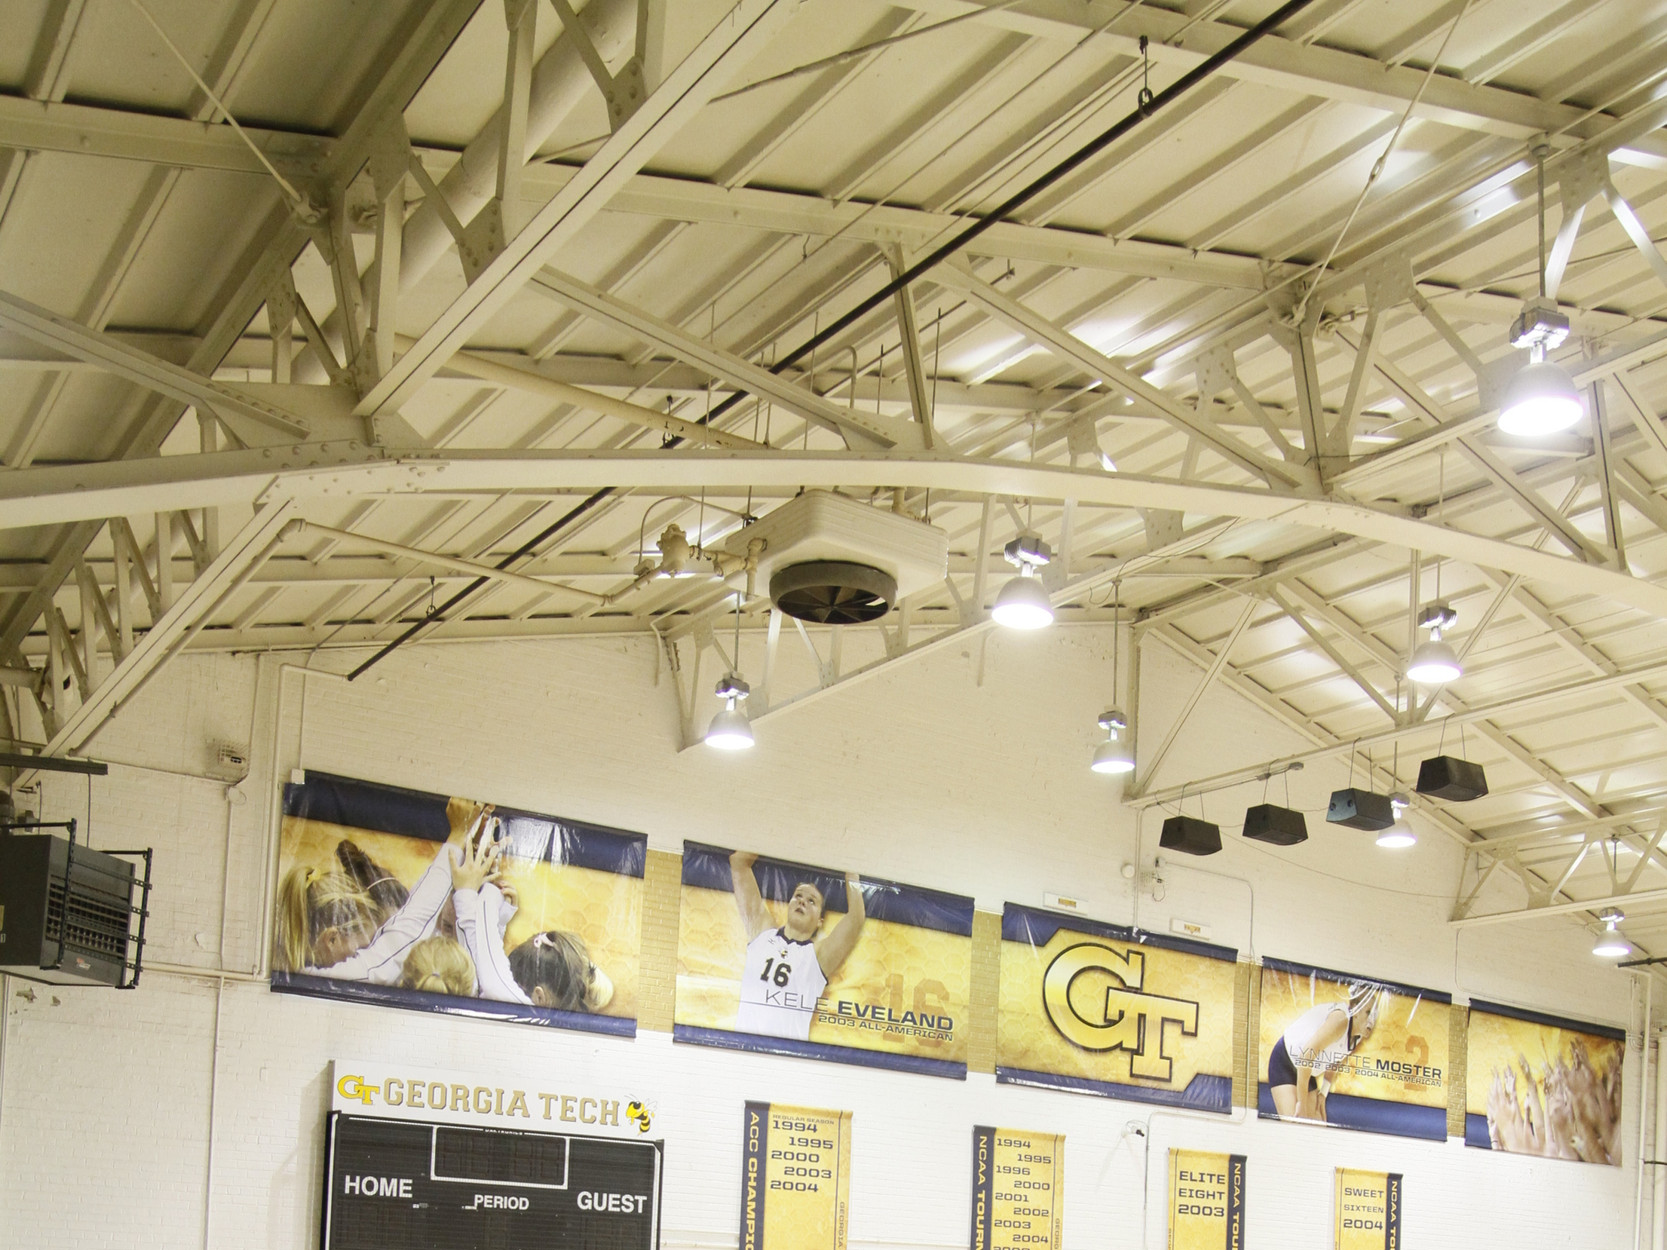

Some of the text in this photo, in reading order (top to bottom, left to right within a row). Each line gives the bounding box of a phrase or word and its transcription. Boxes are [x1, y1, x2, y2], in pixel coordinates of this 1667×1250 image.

[760, 957, 792, 988] 16
[765, 989, 954, 1031] KELE EVELAND
[818, 1014, 953, 1042] 2003 ALL-AMERICAN
[1290, 1045, 1442, 1080] LYNNETTE MOSTER
[1294, 1059, 1442, 1087] 2002 2003 2004 ALL-AMERICAN
[337, 1075, 620, 1126] GT GEORGIA TECH
[772, 1114, 834, 1125] REGULAR SEASON
[749, 1111, 760, 1152] ACC
[772, 1120, 818, 1133] 1994
[789, 1137, 834, 1149] 1995
[997, 1138, 1031, 1149] 1994
[771, 1150, 820, 1163] 2000
[978, 1135, 988, 1185] NCAA
[1017, 1154, 1052, 1164] 1995
[784, 1166, 832, 1179] 2003
[996, 1165, 1031, 1175] 1996
[1179, 1170, 1226, 1184] ELITE
[344, 1175, 413, 1199] HOME
[770, 1180, 819, 1192] 2004
[1014, 1180, 1050, 1191] 2000
[1233, 1163, 1241, 1208] NCAA
[994, 1192, 1029, 1202] 2001
[1178, 1188, 1225, 1200] EIGHT
[1344, 1187, 1385, 1198] SWEET
[474, 1194, 530, 1211] PERIOD
[576, 1190, 648, 1214] GUEST
[1390, 1181, 1398, 1222] NCAA
[1013, 1207, 1049, 1217] 2002
[1178, 1204, 1225, 1217] 2003
[1343, 1204, 1384, 1213] SIXTEEN
[994, 1219, 1031, 1229] 2003
[1343, 1218, 1383, 1230] 2004
[1013, 1234, 1049, 1243] 2004
